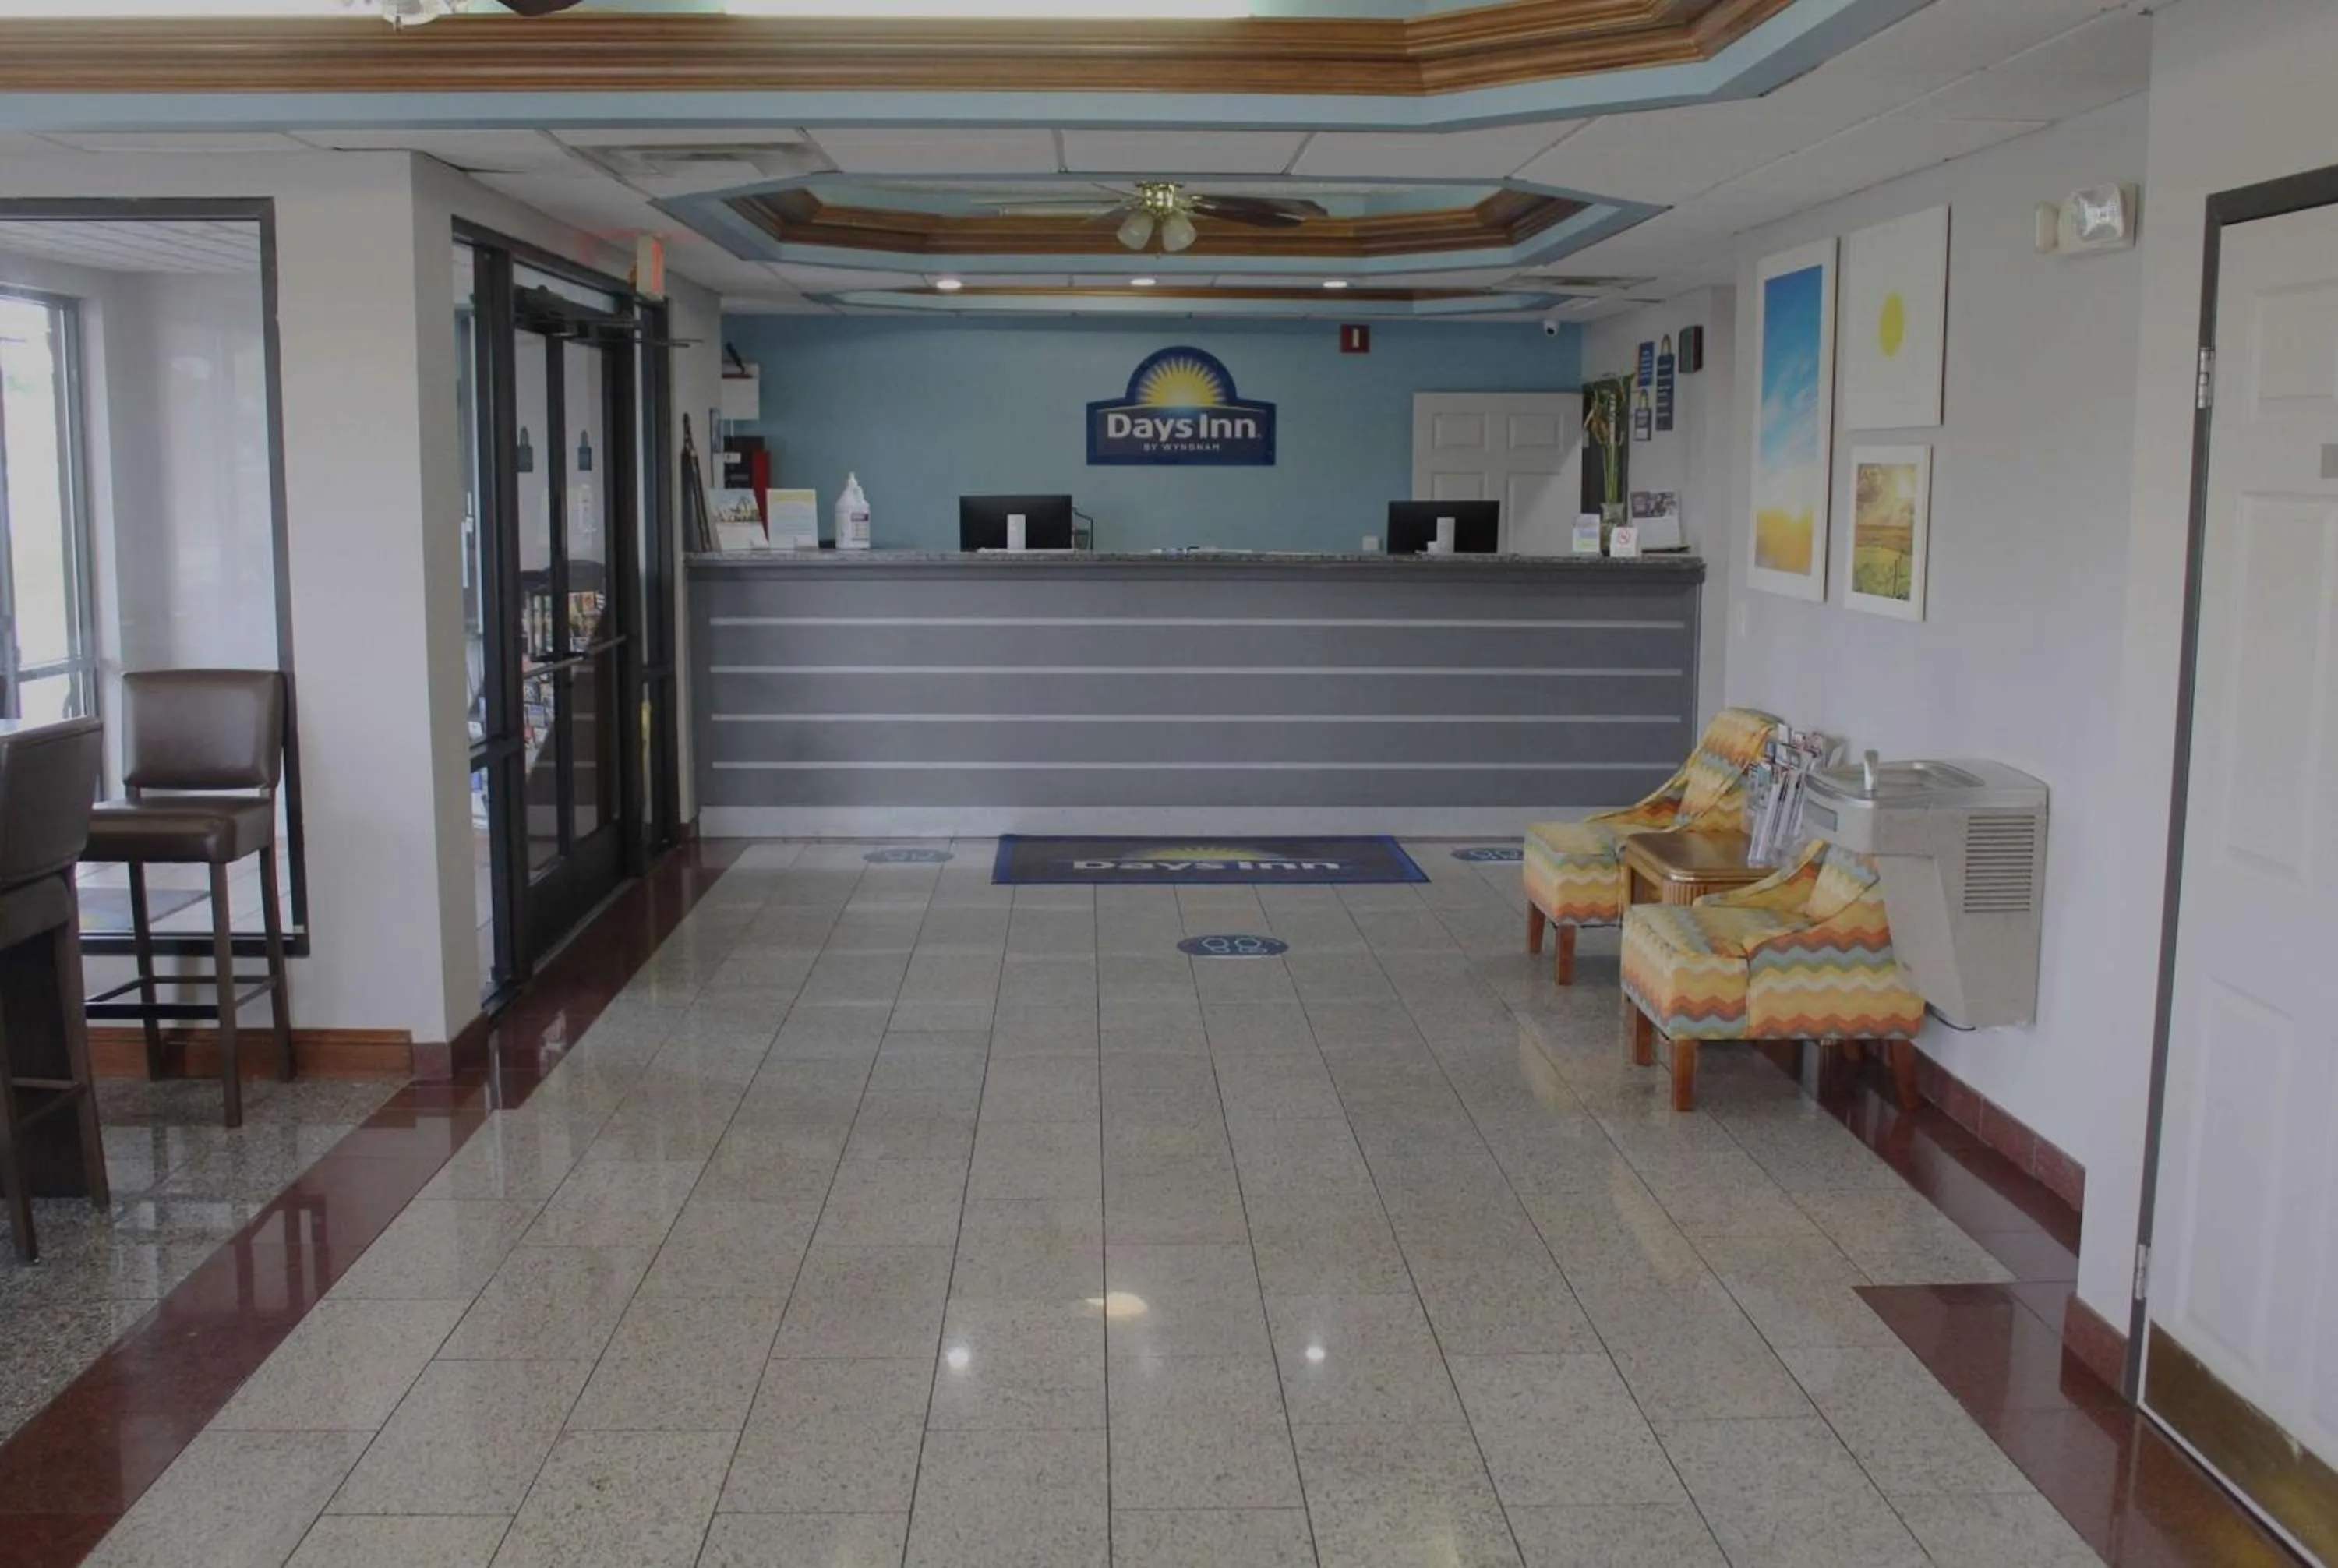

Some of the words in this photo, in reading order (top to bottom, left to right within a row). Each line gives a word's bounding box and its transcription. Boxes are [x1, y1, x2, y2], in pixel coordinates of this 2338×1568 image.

[1107, 412, 1193, 442] Days
[1199, 412, 1256, 439] Inn
[1143, 443, 1158, 452] BY
[1072, 860, 1225, 871] Days
[1238, 860, 1340, 870] Inn
